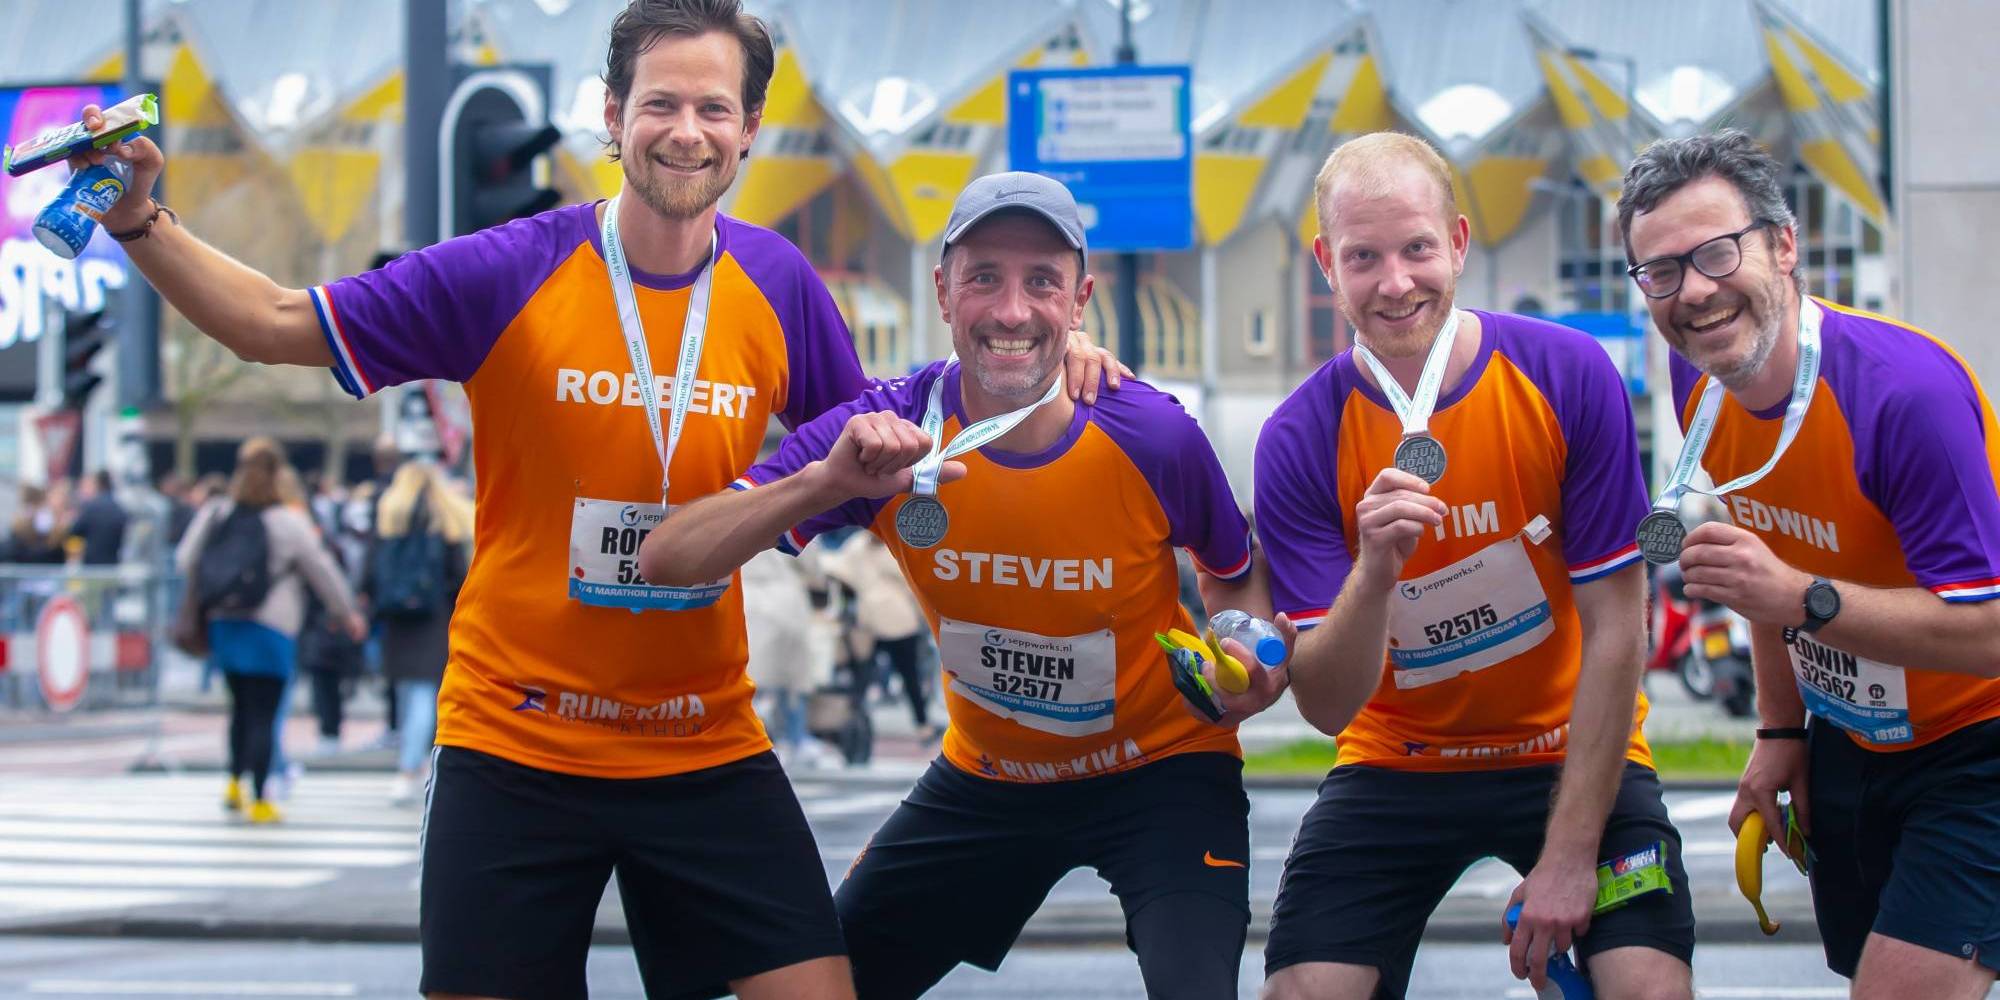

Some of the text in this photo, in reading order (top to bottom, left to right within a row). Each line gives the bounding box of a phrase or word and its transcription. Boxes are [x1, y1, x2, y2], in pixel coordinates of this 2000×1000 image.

[556, 368, 756, 419] ROBBERT
[1729, 495, 1840, 553] EDWIN
[933, 549, 1112, 592] STEVEN
[1423, 560, 1484, 592] seppworks.nl
[595, 587, 648, 598] MARATHON
[650, 591, 704, 600] ROTTERDAM
[1413, 642, 1463, 659] MARATHON
[1465, 619, 1518, 647] ROTTERDAM
[1424, 603, 1498, 645] 52575
[980, 645, 1074, 680] STEVEN
[1008, 638, 1072, 652] seppworks.nl
[1794, 637, 1858, 677] EDWIN
[993, 672, 1062, 701] 52577
[1800, 659, 1856, 704] 52562
[557, 691, 621, 720] RUN
[1023, 700, 1079, 713] ROTTERDAM
[1082, 703, 1106, 713] 2023
